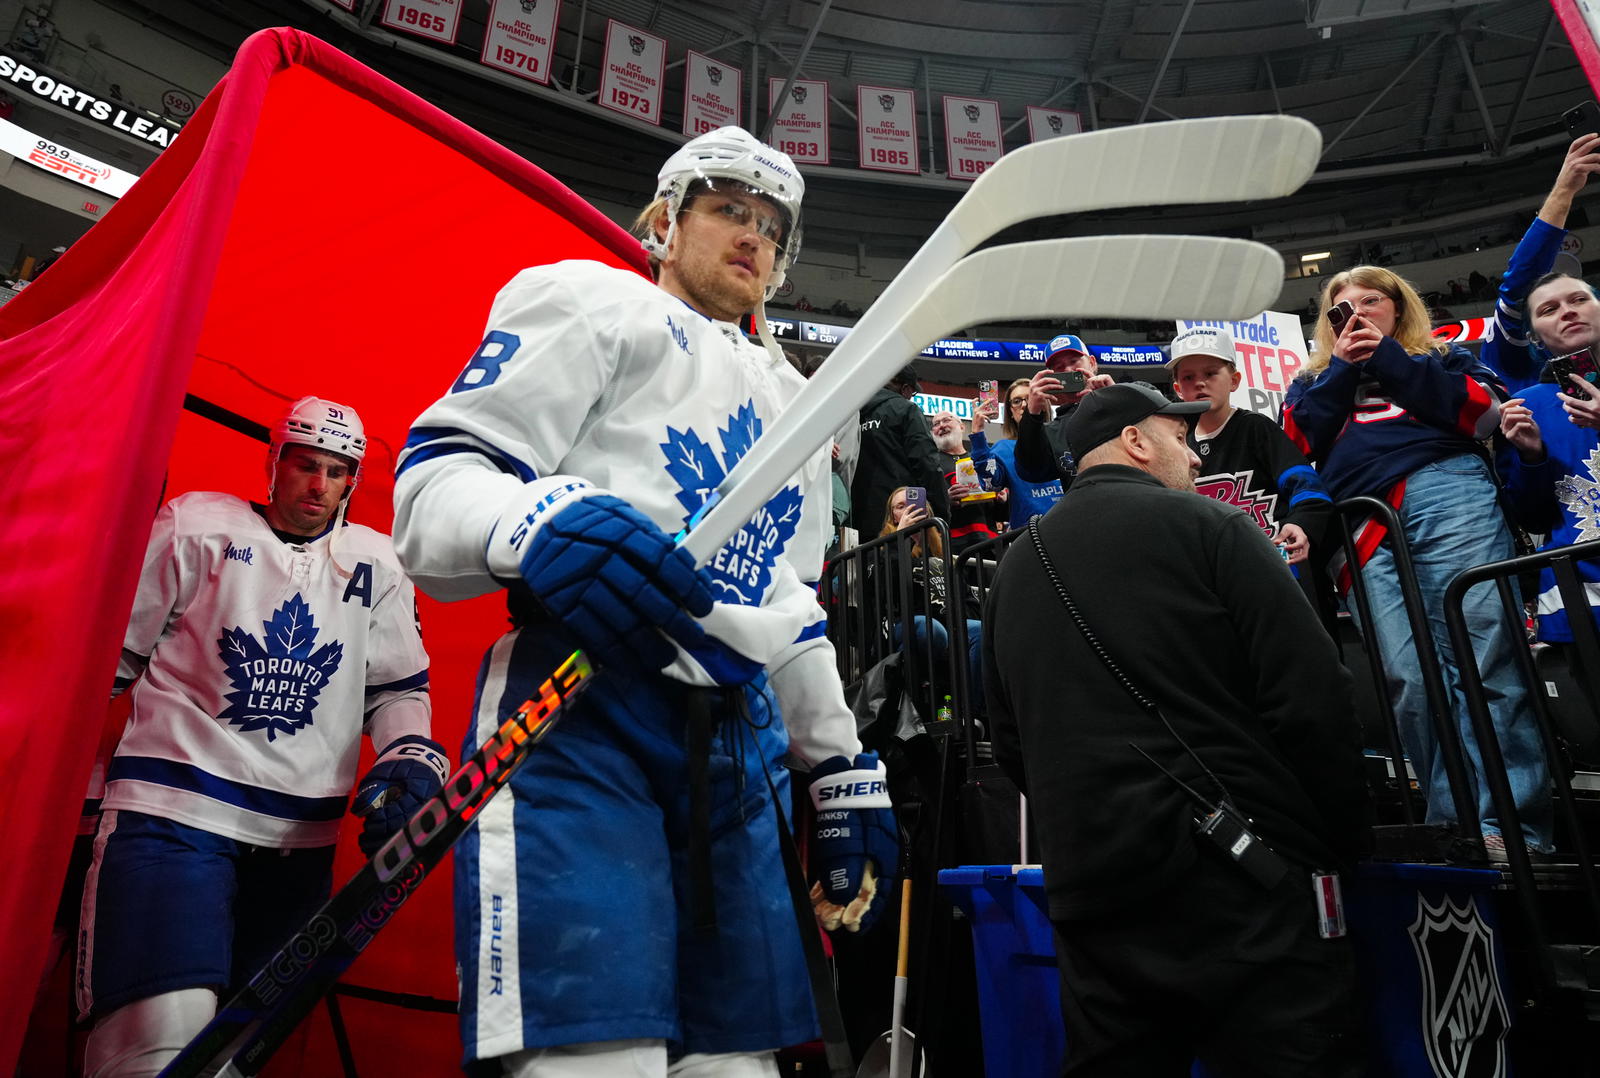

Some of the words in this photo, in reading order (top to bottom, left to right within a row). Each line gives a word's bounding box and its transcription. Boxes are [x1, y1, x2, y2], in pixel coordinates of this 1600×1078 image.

[398, 5, 446, 33] 1965
[514, 20, 532, 32] ACC
[496, 21, 547, 46] CHAMPIONS
[497, 45, 539, 73] 1970
[626, 62, 642, 73] ACC
[610, 64, 657, 86] CHAMPIONS
[0, 55, 112, 121] SPORTS
[113, 110, 179, 148] LEA
[167, 95, 191, 112] 329
[612, 87, 651, 114] 1973
[691, 94, 735, 115] CHAMPIONS
[706, 92, 720, 103] ACC
[694, 117, 720, 135] 197
[775, 119, 822, 129] CHAMPIONS
[865, 126, 911, 138] CHAMPIONS
[880, 121, 895, 129] ACC
[953, 137, 997, 148] CHAMPIONS
[967, 131, 982, 139] ACC
[35, 140, 70, 160] 99.9
[780, 141, 818, 156] 1983
[870, 148, 909, 165] 1985
[28, 148, 100, 185] ESPN
[820, 334, 838, 344] CGY
[935, 341, 974, 349] LEADERS
[451, 330, 521, 394] 8
[945, 349, 988, 358] MATTHEWS
[994, 350, 999, 358] 2
[1019, 350, 1044, 360] 25.47
[1128, 353, 1145, 363] (102
[1146, 352, 1162, 362] PTS)
[328, 408, 344, 420] 91
[320, 427, 352, 440] CCM
[696, 487, 779, 550] TNTO
[223, 541, 254, 566] Milk
[728, 528, 767, 563] PLE
[706, 548, 761, 588] EAFS
[342, 562, 373, 608] A
[240, 658, 323, 686] TORONTO
[251, 677, 310, 697] MAPLE
[247, 693, 305, 713] LEAFS
